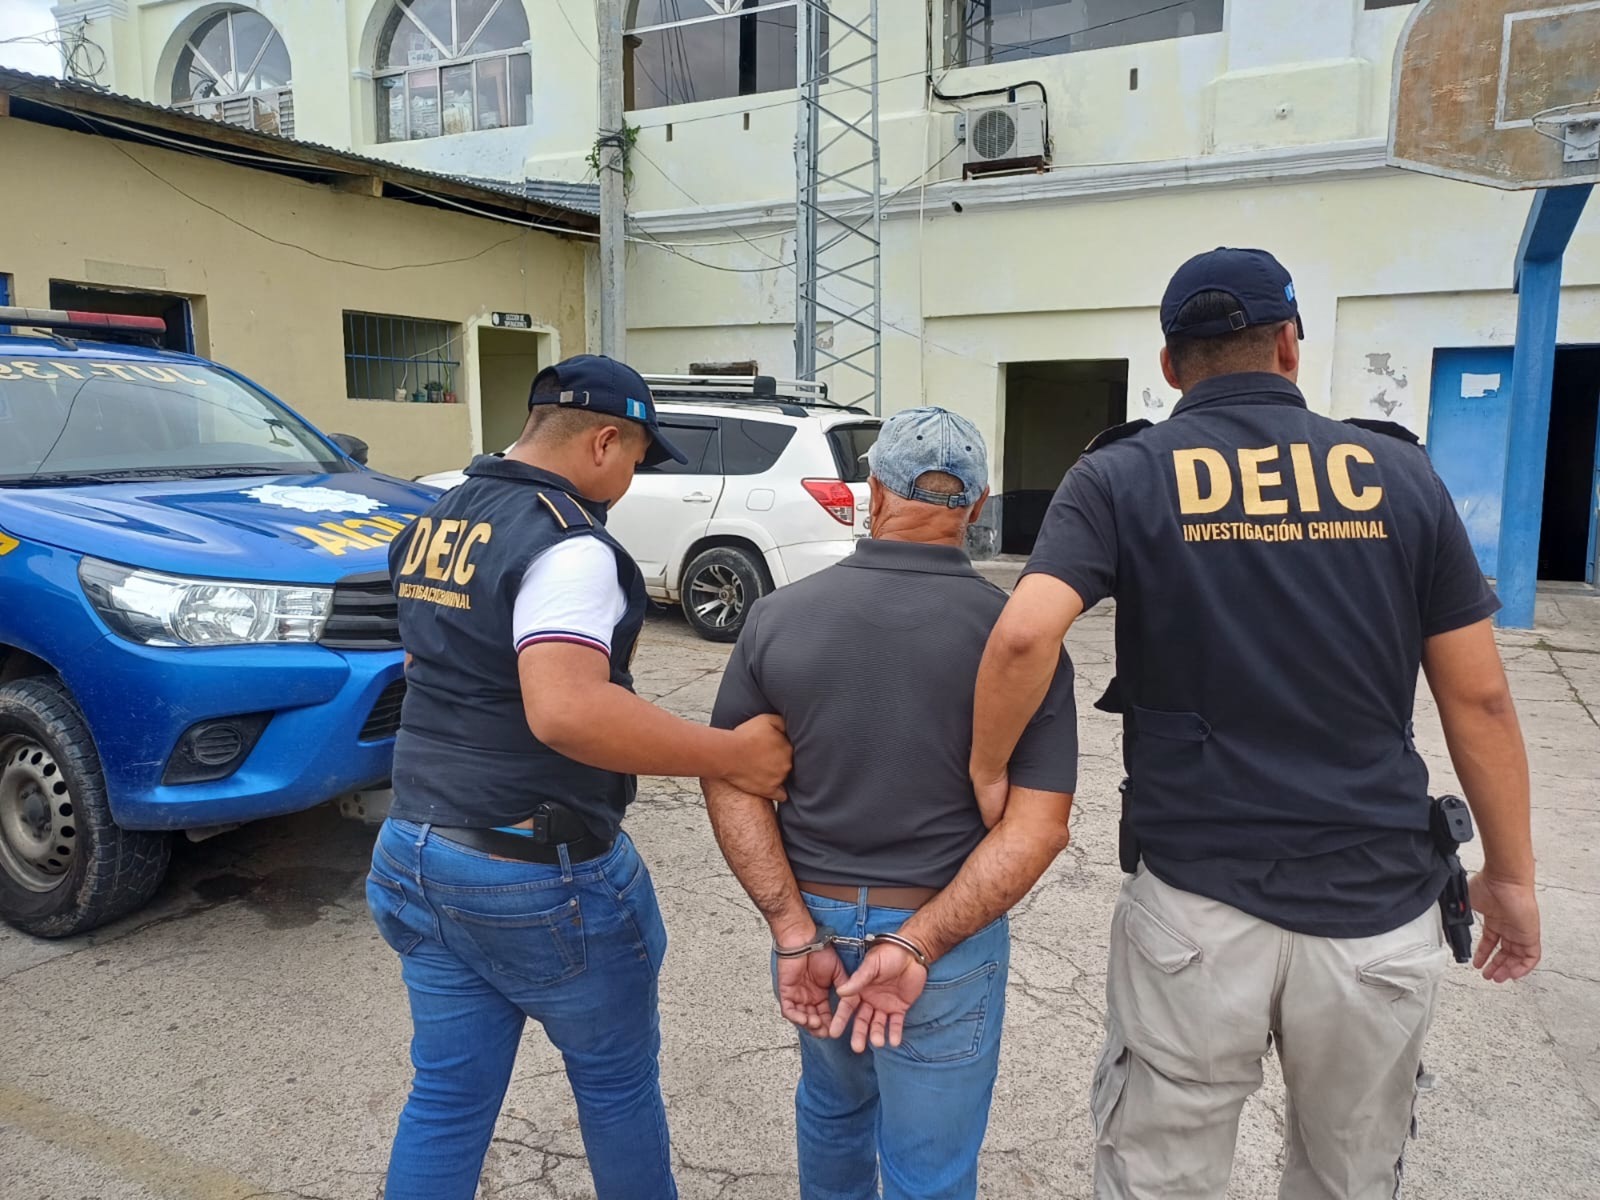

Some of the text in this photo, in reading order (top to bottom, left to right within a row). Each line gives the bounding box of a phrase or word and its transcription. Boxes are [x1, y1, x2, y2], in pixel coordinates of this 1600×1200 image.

[1172, 443, 1383, 515] DEIC
[400, 517, 492, 585] DEIC
[1183, 519, 1387, 542] INVESTIGACIÓN CRIMINAL
